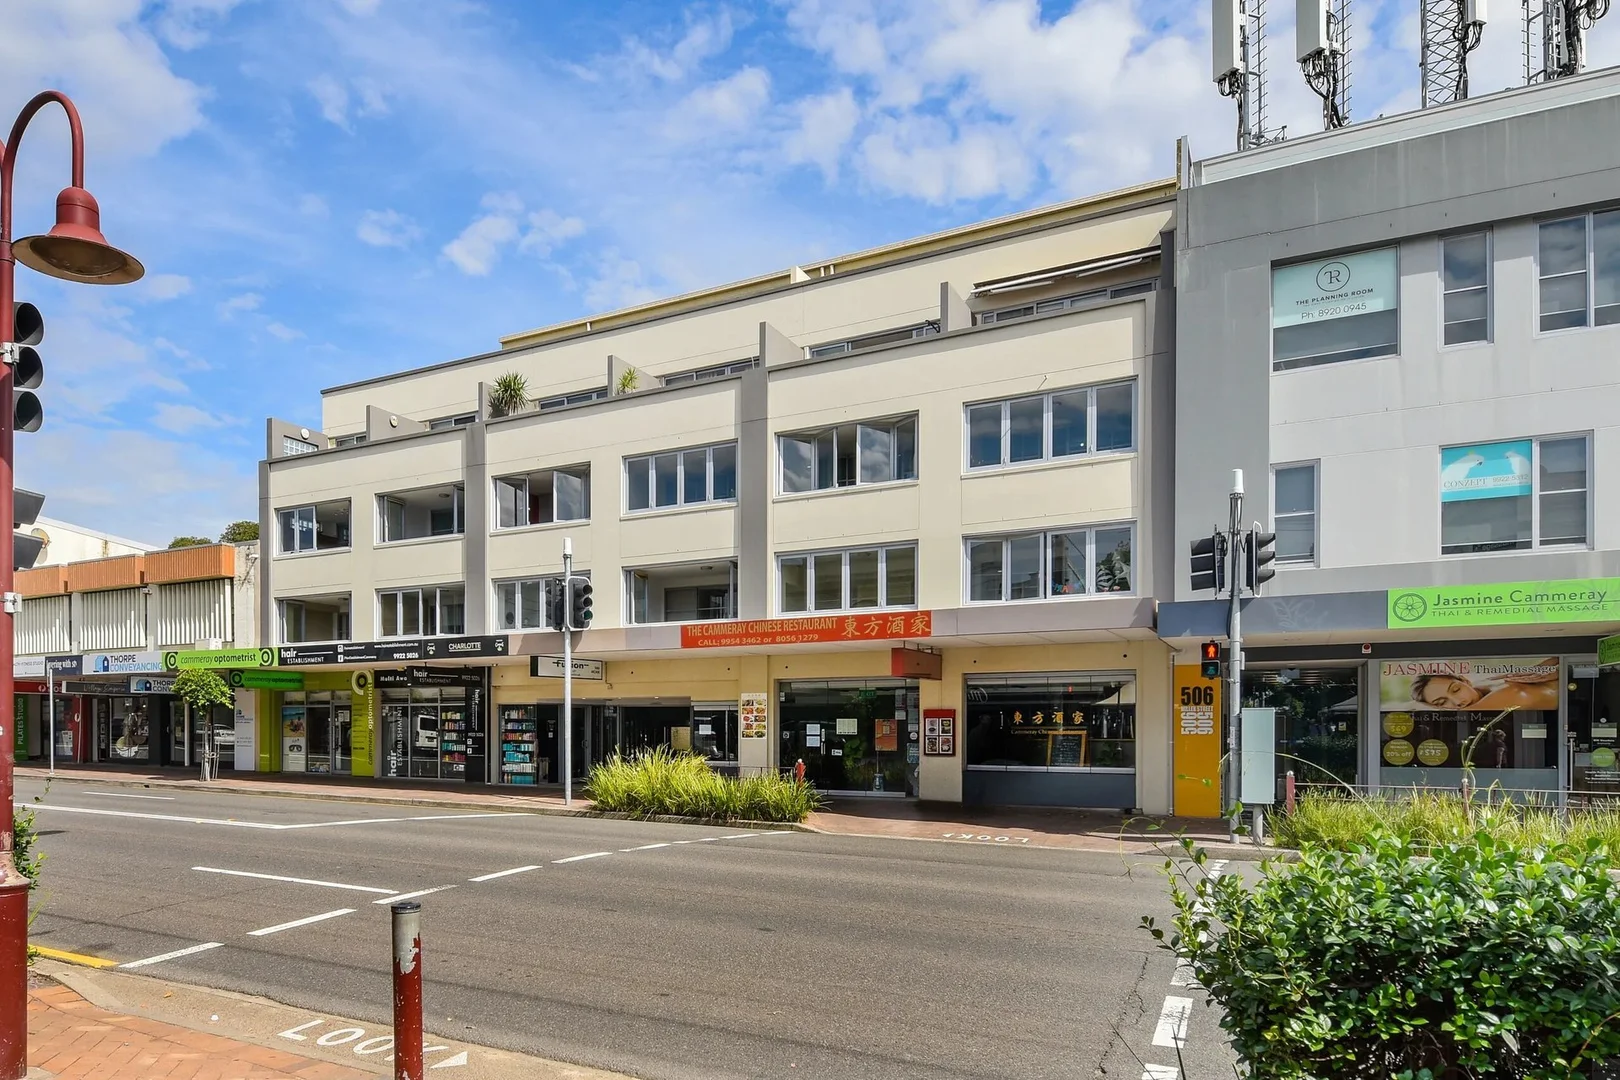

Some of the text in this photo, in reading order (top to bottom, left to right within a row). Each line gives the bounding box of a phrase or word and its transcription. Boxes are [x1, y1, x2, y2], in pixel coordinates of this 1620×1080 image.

[1311, 292, 1349, 303] PLANNING
[1351, 288, 1374, 296] ROOM
[1301, 302, 1367, 320] Ph: 8920 0945
[1443, 478, 1487, 489] CONZEPT
[1433, 589, 1607, 606] Jasmine Cammeray
[1476, 607, 1543, 616] REMEDIAL
[1546, 603, 1609, 613] MASSAGE
[687, 617, 838, 636] THE CAMMERAY CHINESE RESTAURANT
[841, 611, 931, 638] 東方酒家
[721, 637, 740, 645] 9954
[741, 636, 761, 644] 3462
[798, 633, 819, 641] 1279
[448, 642, 482, 650] CHARLOTTE
[110, 654, 137, 663] THORPE
[180, 652, 257, 665] cammeray optometrist
[281, 648, 297, 658] hair
[287, 656, 325, 664] ESTABLISHMENT
[110, 662, 163, 672] CONVEYANCING
[413, 668, 428, 678] hair
[1383, 661, 1471, 676] JASMINE
[152, 679, 176, 687] THORP
[1181, 686, 1214, 706] 506
[1013, 710, 1084, 725] 東方酒家
[387, 750, 397, 777] hair
